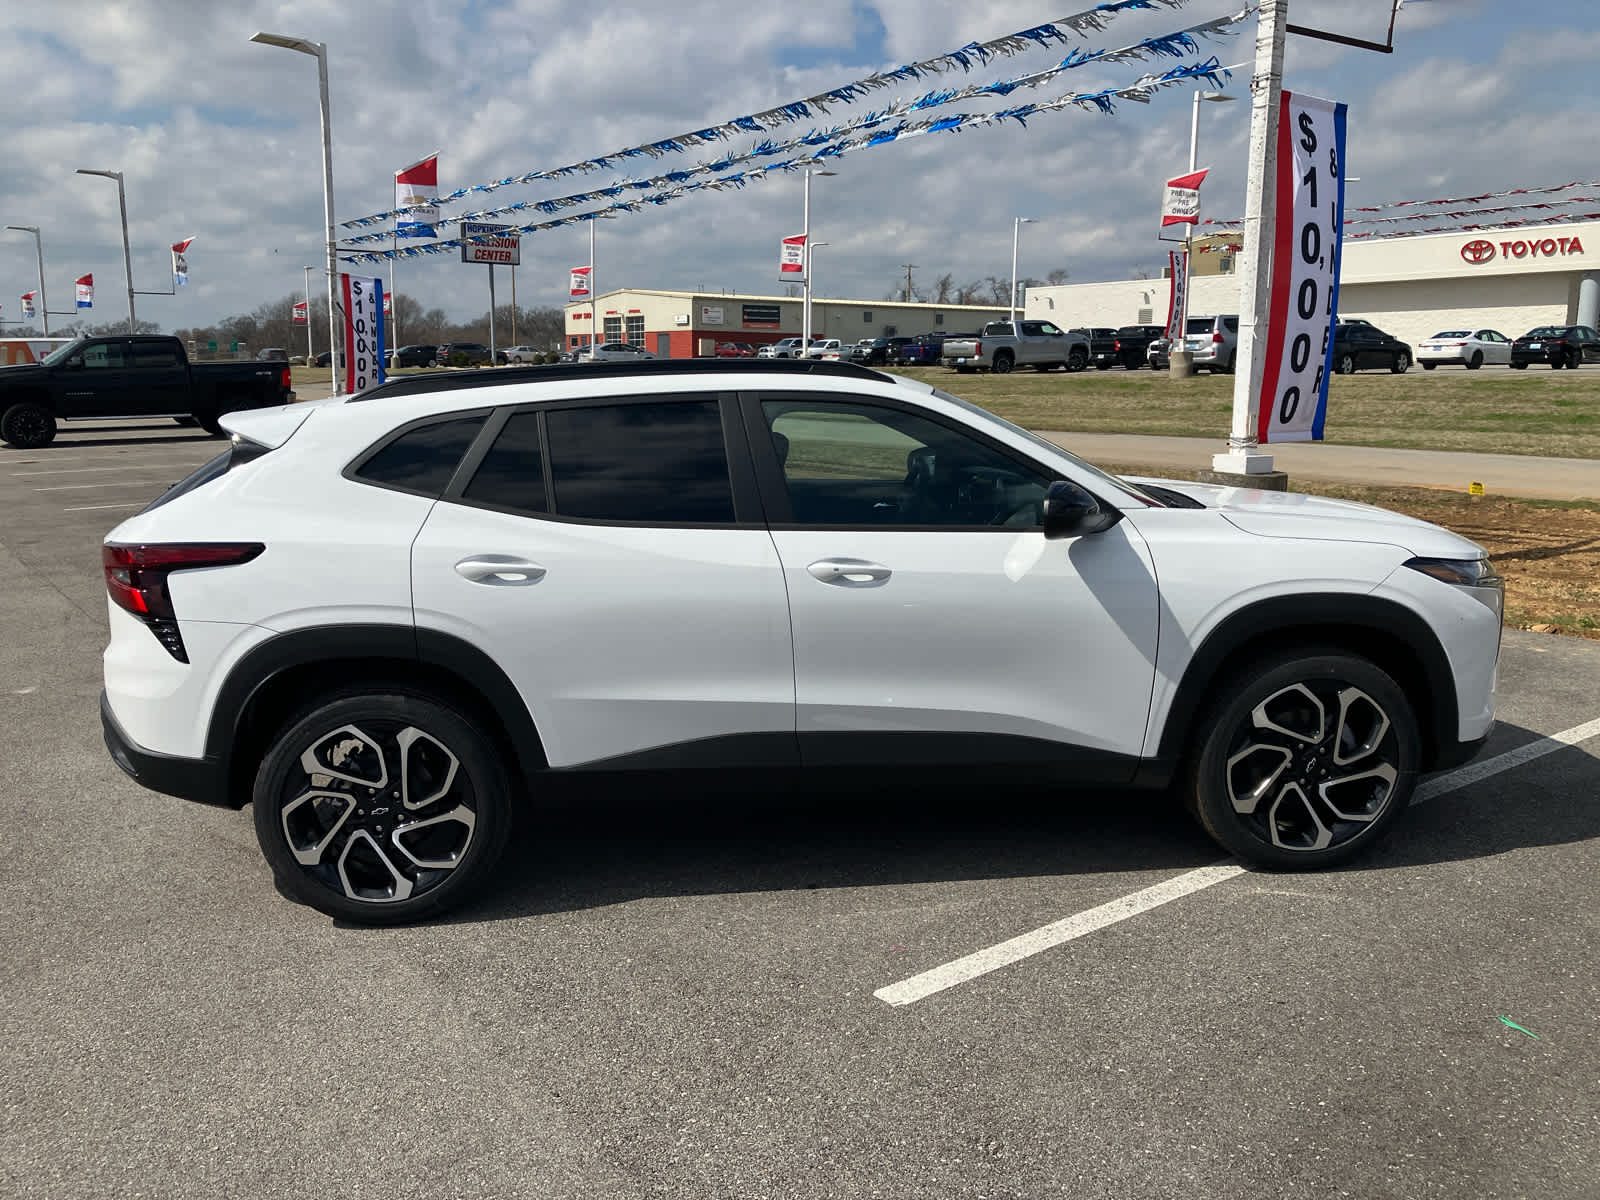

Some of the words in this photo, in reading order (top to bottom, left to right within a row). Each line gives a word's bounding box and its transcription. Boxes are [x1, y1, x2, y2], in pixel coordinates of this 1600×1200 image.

[468, 237, 517, 248] OLLISION
[474, 249, 512, 261] CENTER
[1500, 237, 1583, 257] TOYOTA
[1280, 111, 1324, 424] $10,000
[353, 281, 368, 390] $10,000
[370, 311, 378, 380] UNDER
